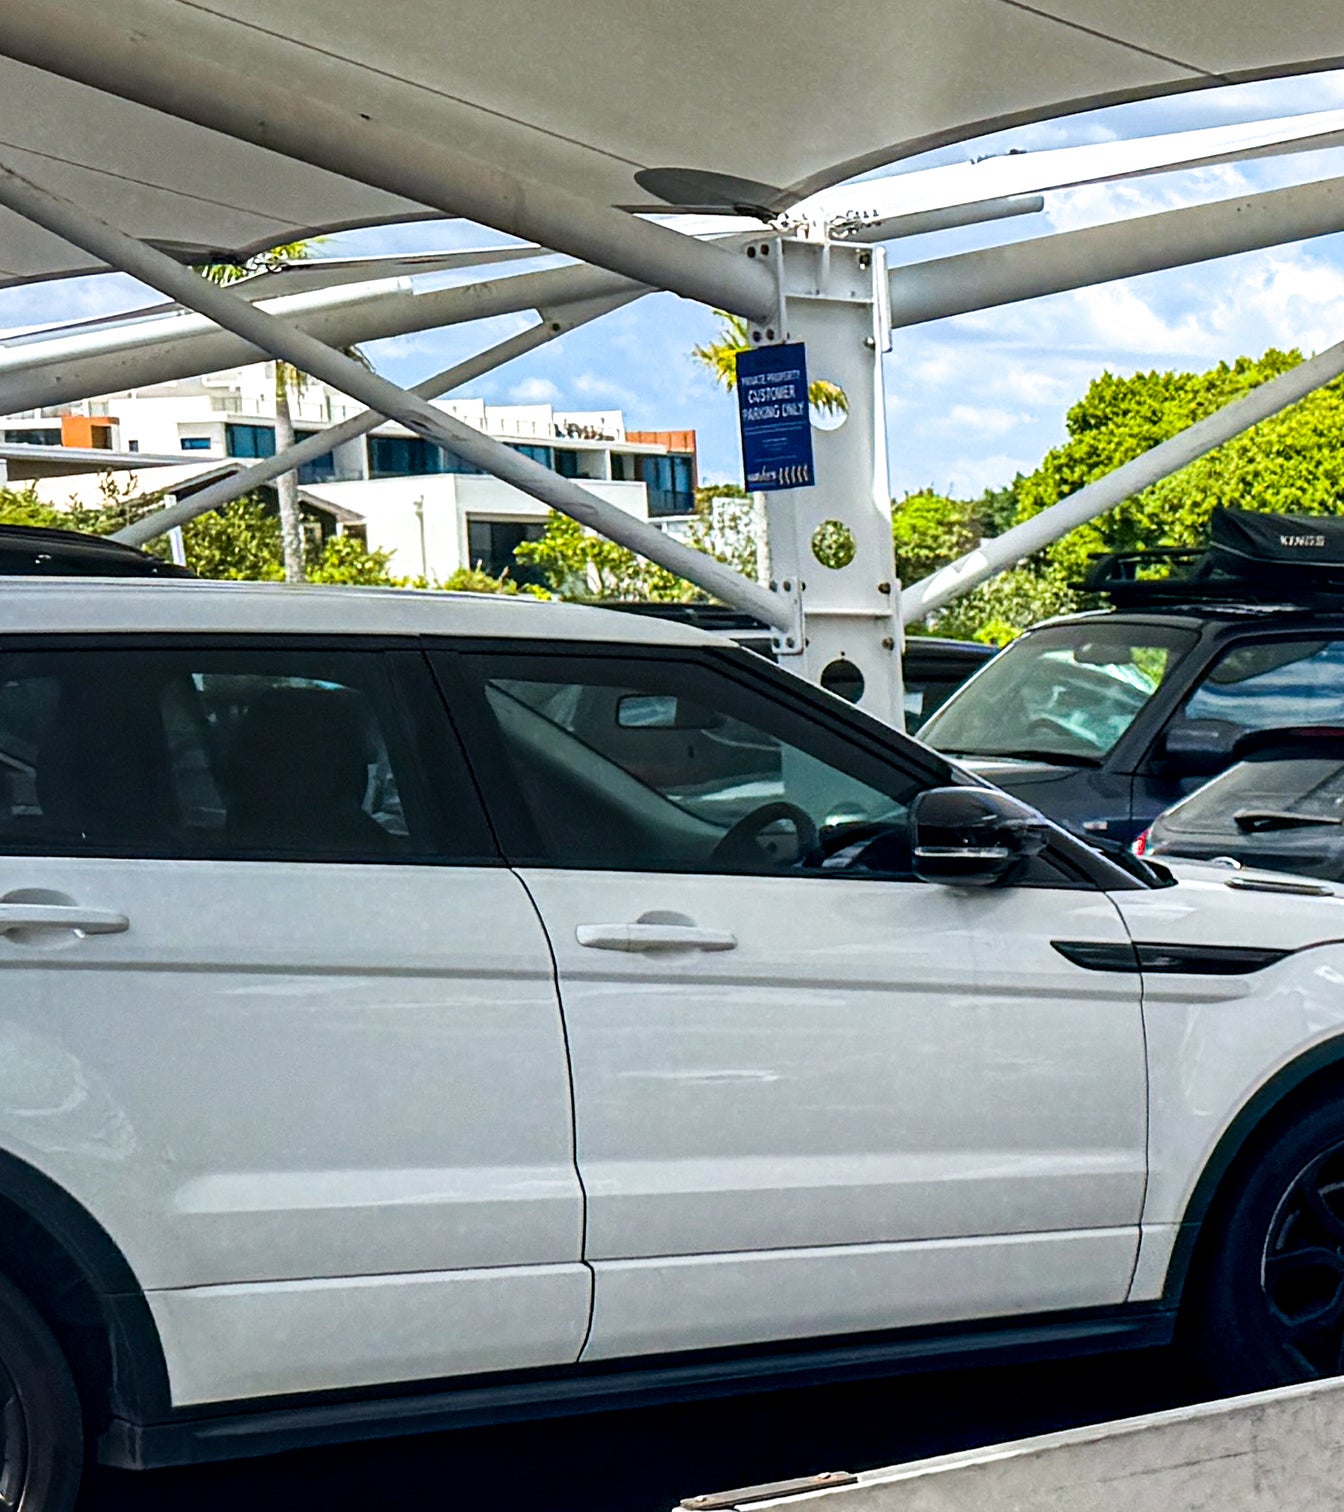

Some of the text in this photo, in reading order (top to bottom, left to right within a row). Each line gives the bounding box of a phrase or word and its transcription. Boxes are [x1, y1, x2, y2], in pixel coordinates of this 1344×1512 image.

[748, 384, 796, 403] CUSTOMER
[742, 401, 805, 421] PARKING ONLY
[1280, 535, 1325, 547] KINGS
